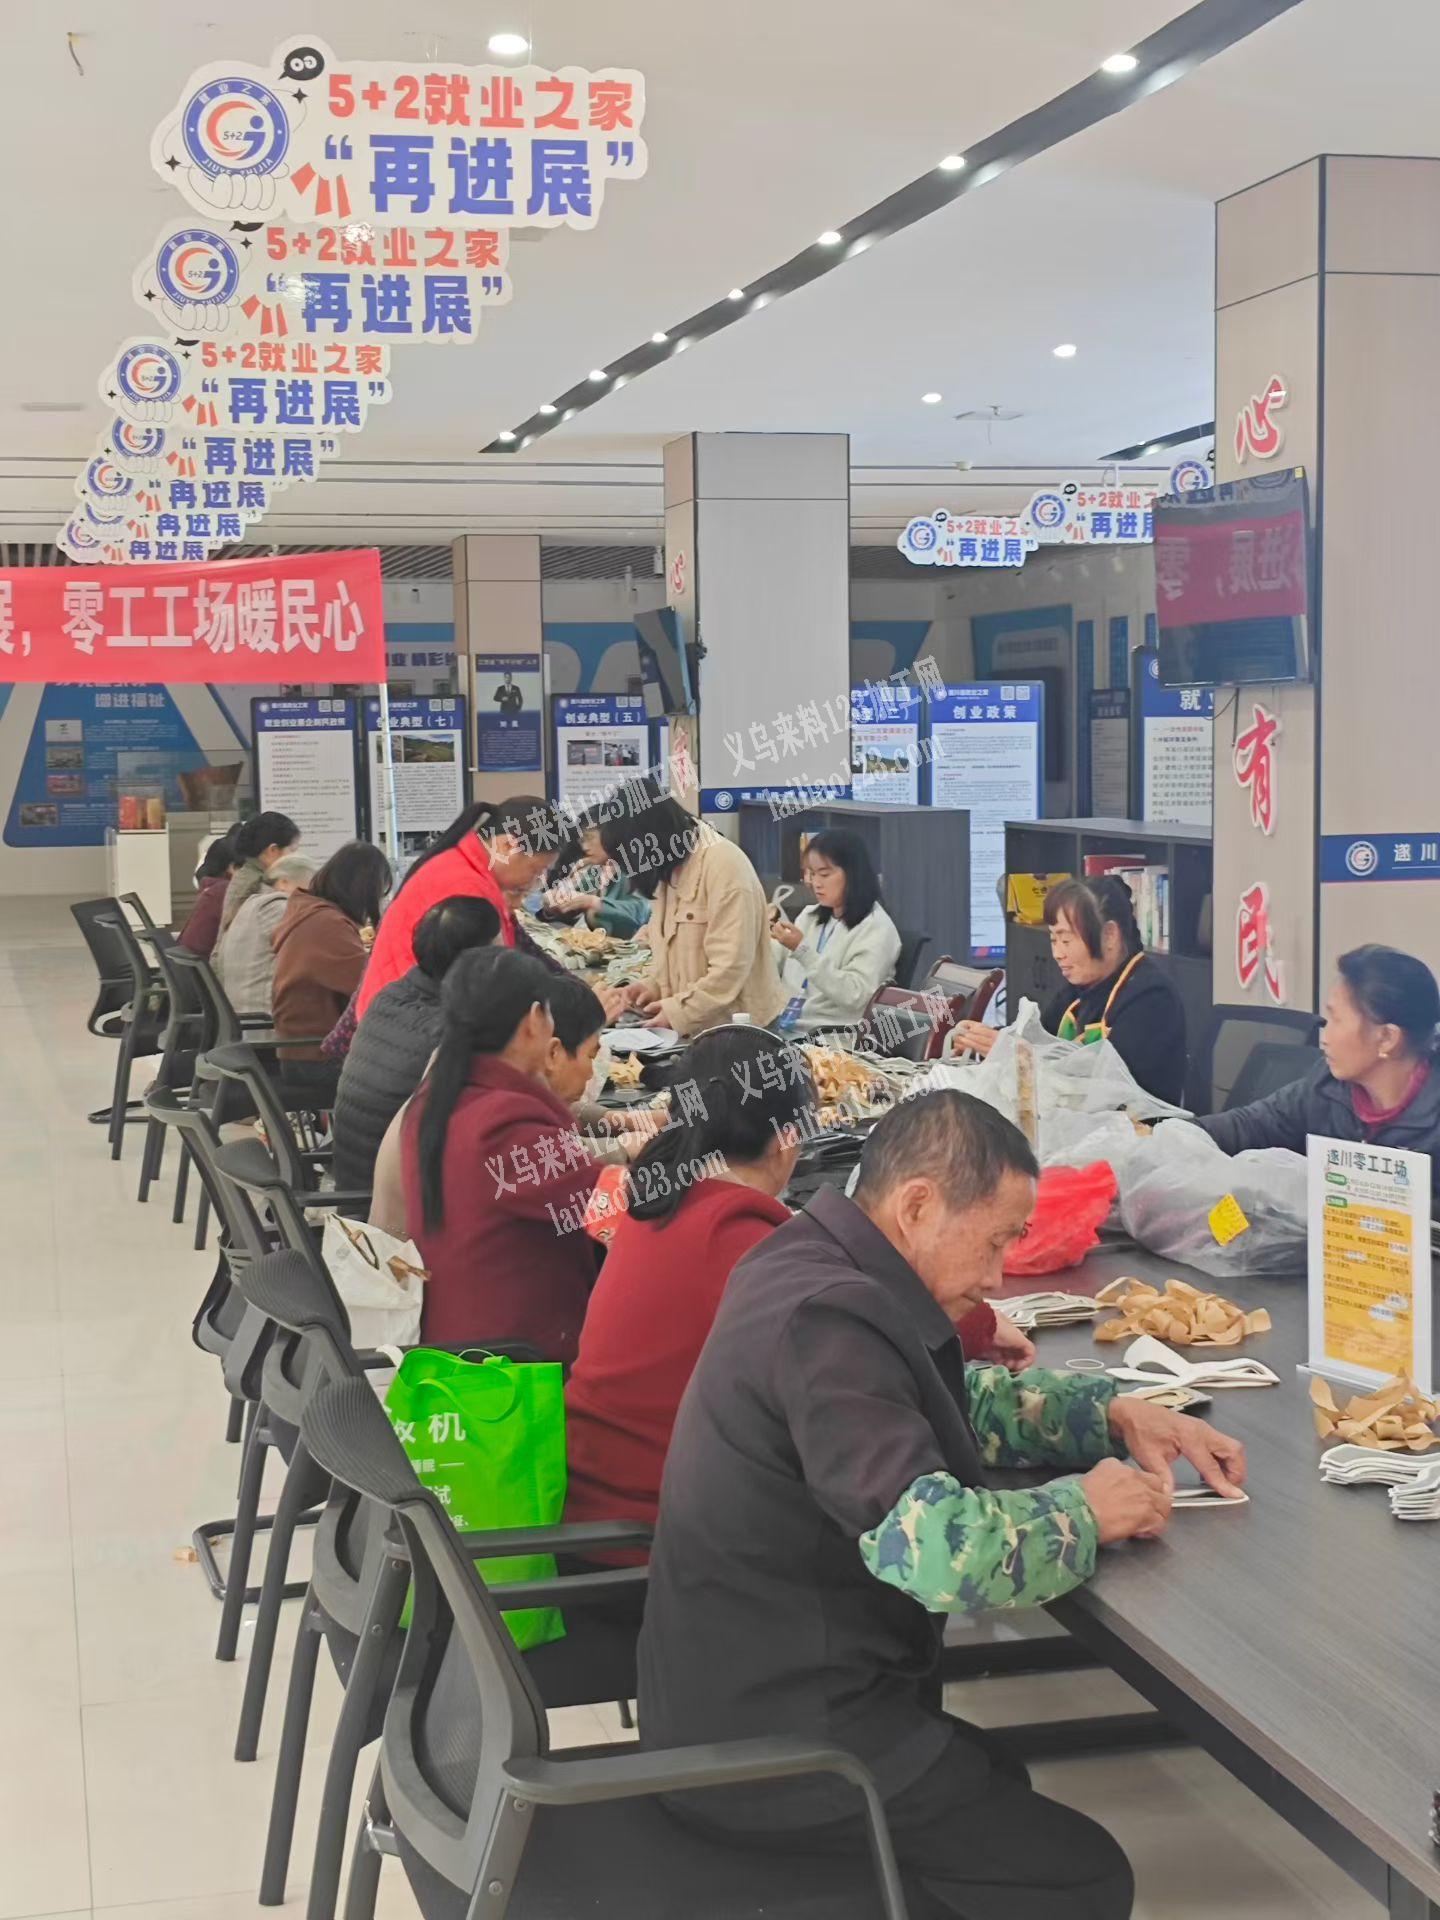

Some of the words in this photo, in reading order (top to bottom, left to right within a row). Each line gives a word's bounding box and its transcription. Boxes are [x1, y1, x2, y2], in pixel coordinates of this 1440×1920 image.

[328, 73, 634, 130] 5+2就业之家
[222, 130, 243, 141] 5+2
[324, 134, 634, 217] “再进展”
[266, 226, 500, 268] 5+2就业之家
[266, 272, 503, 335] “再进展”
[201, 341, 383, 376] 5+2就业之家
[201, 377, 386, 427] “再进展”
[182, 436, 335, 477] “再进展”
[945, 537, 1035, 563] “再进展”
[385, 653, 407, 667] 业
[952, 704, 1018, 720] 创业政策
[1180, 689, 1214, 711] 就
[1327, 1149, 1408, 1178] 遂川零工工场
